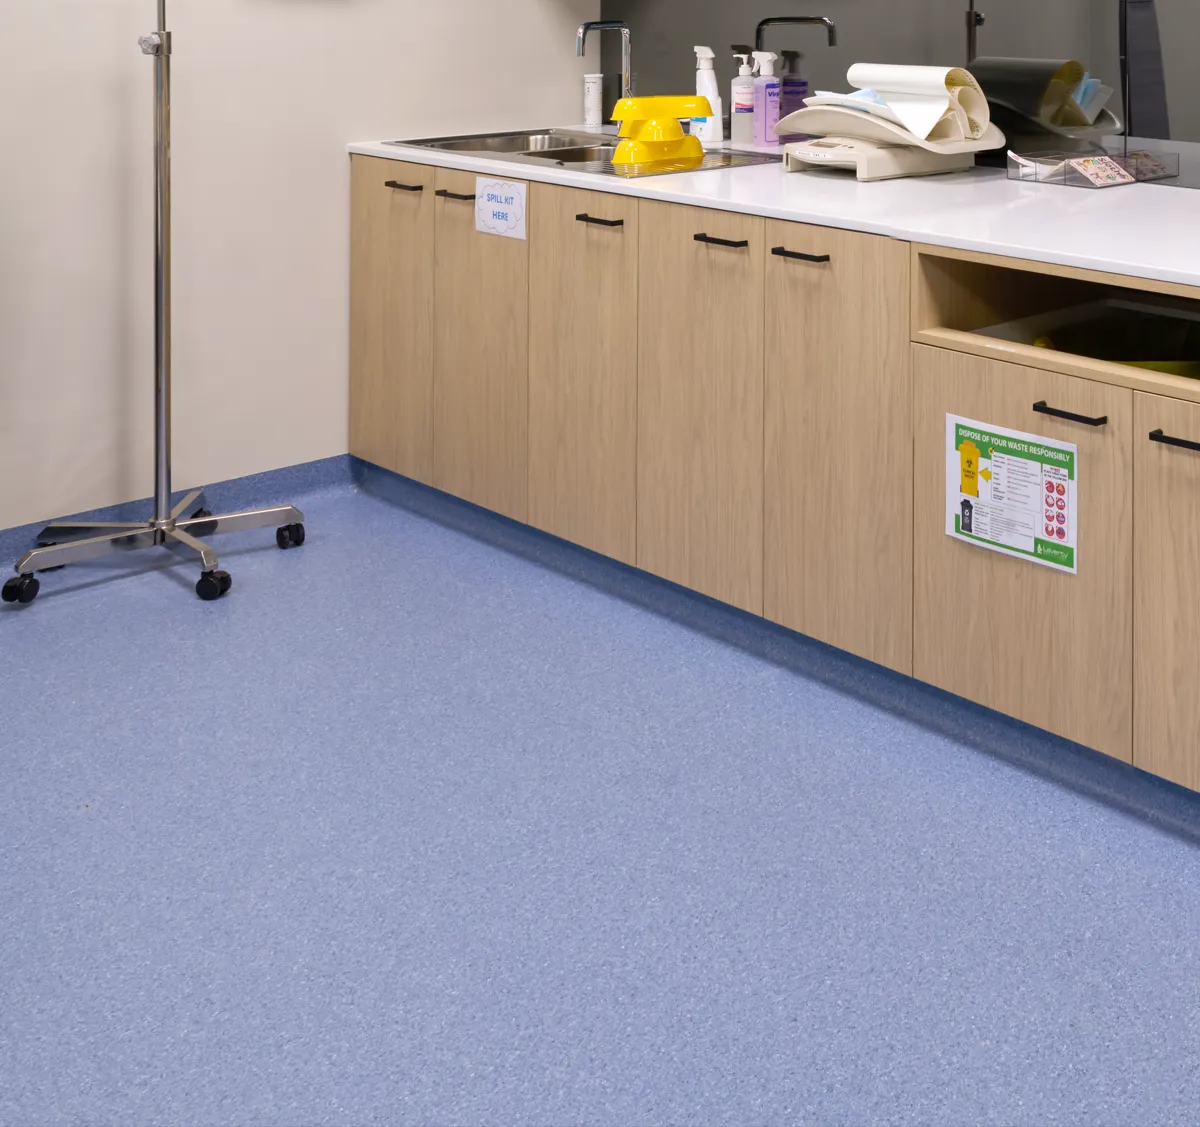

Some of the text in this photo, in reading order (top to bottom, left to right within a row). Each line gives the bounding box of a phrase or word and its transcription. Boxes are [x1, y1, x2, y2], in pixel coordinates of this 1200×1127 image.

[487, 194, 514, 205] SPILL KIT
[493, 211, 508, 221] HERE
[959, 429, 981, 441] DISPOSE
[991, 437, 1007, 447] YOUR
[1008, 441, 1029, 453] WASTE
[1030, 445, 1070, 462] RESPONSIBLY
